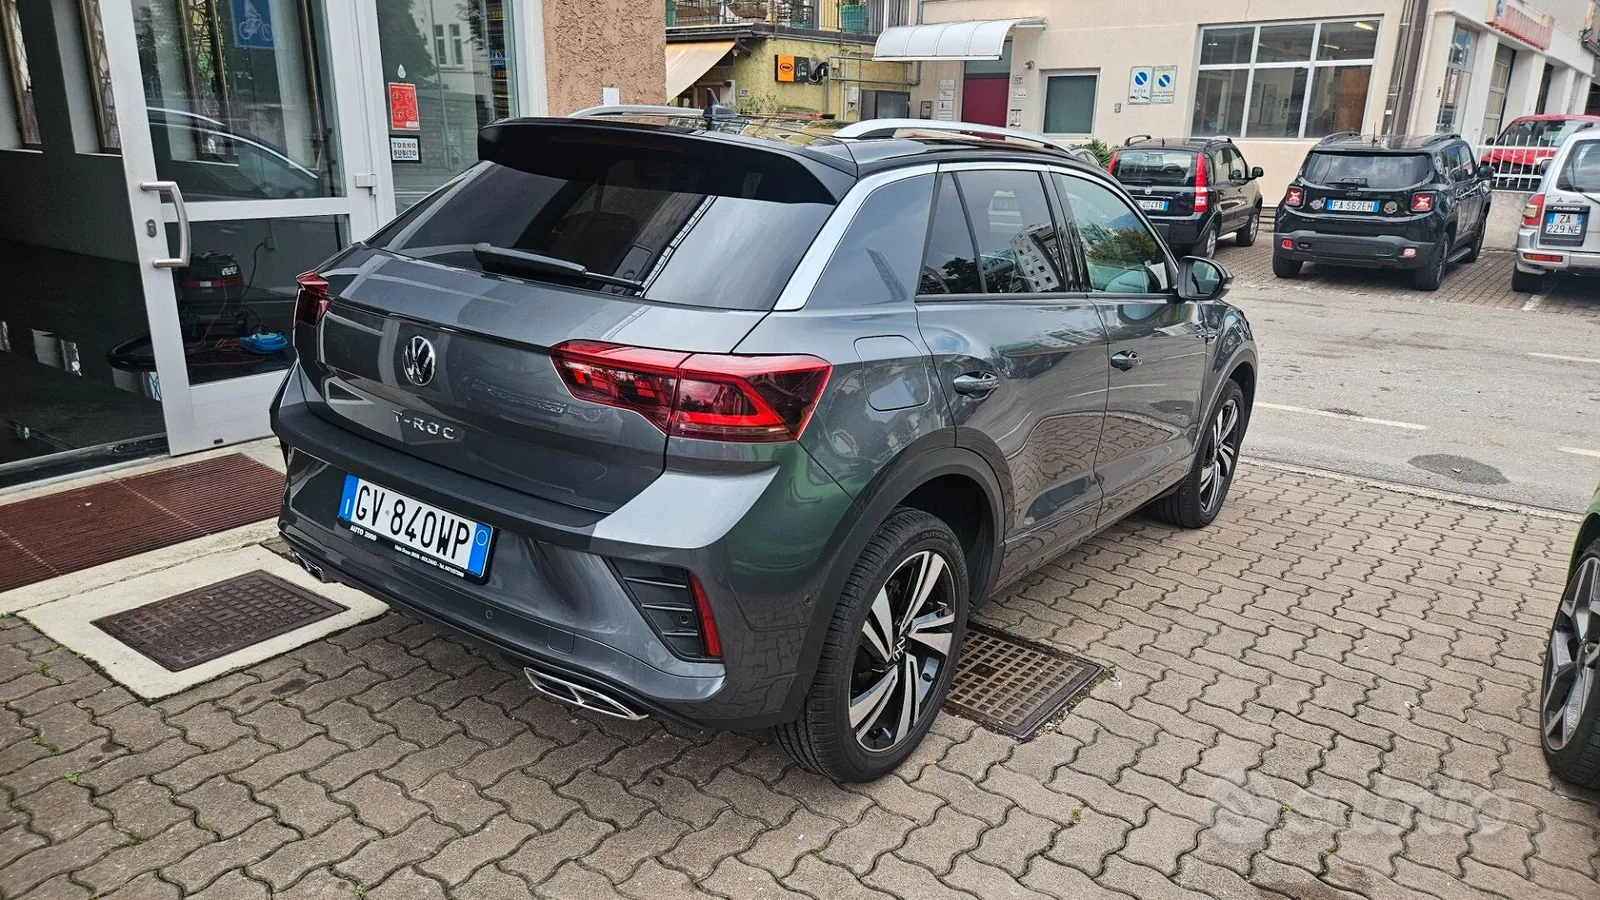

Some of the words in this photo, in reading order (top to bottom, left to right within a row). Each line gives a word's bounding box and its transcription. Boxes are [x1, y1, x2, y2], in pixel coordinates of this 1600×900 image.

[1346, 201, 1373, 210] 562EH
[1560, 214, 1571, 224] ZA
[1547, 224, 1566, 234] 229
[1567, 225, 1580, 234] NE
[392, 409, 455, 440] T-ROC
[355, 485, 386, 527] GV
[390, 498, 471, 560] 840WP
[350, 525, 364, 536] AUTO
